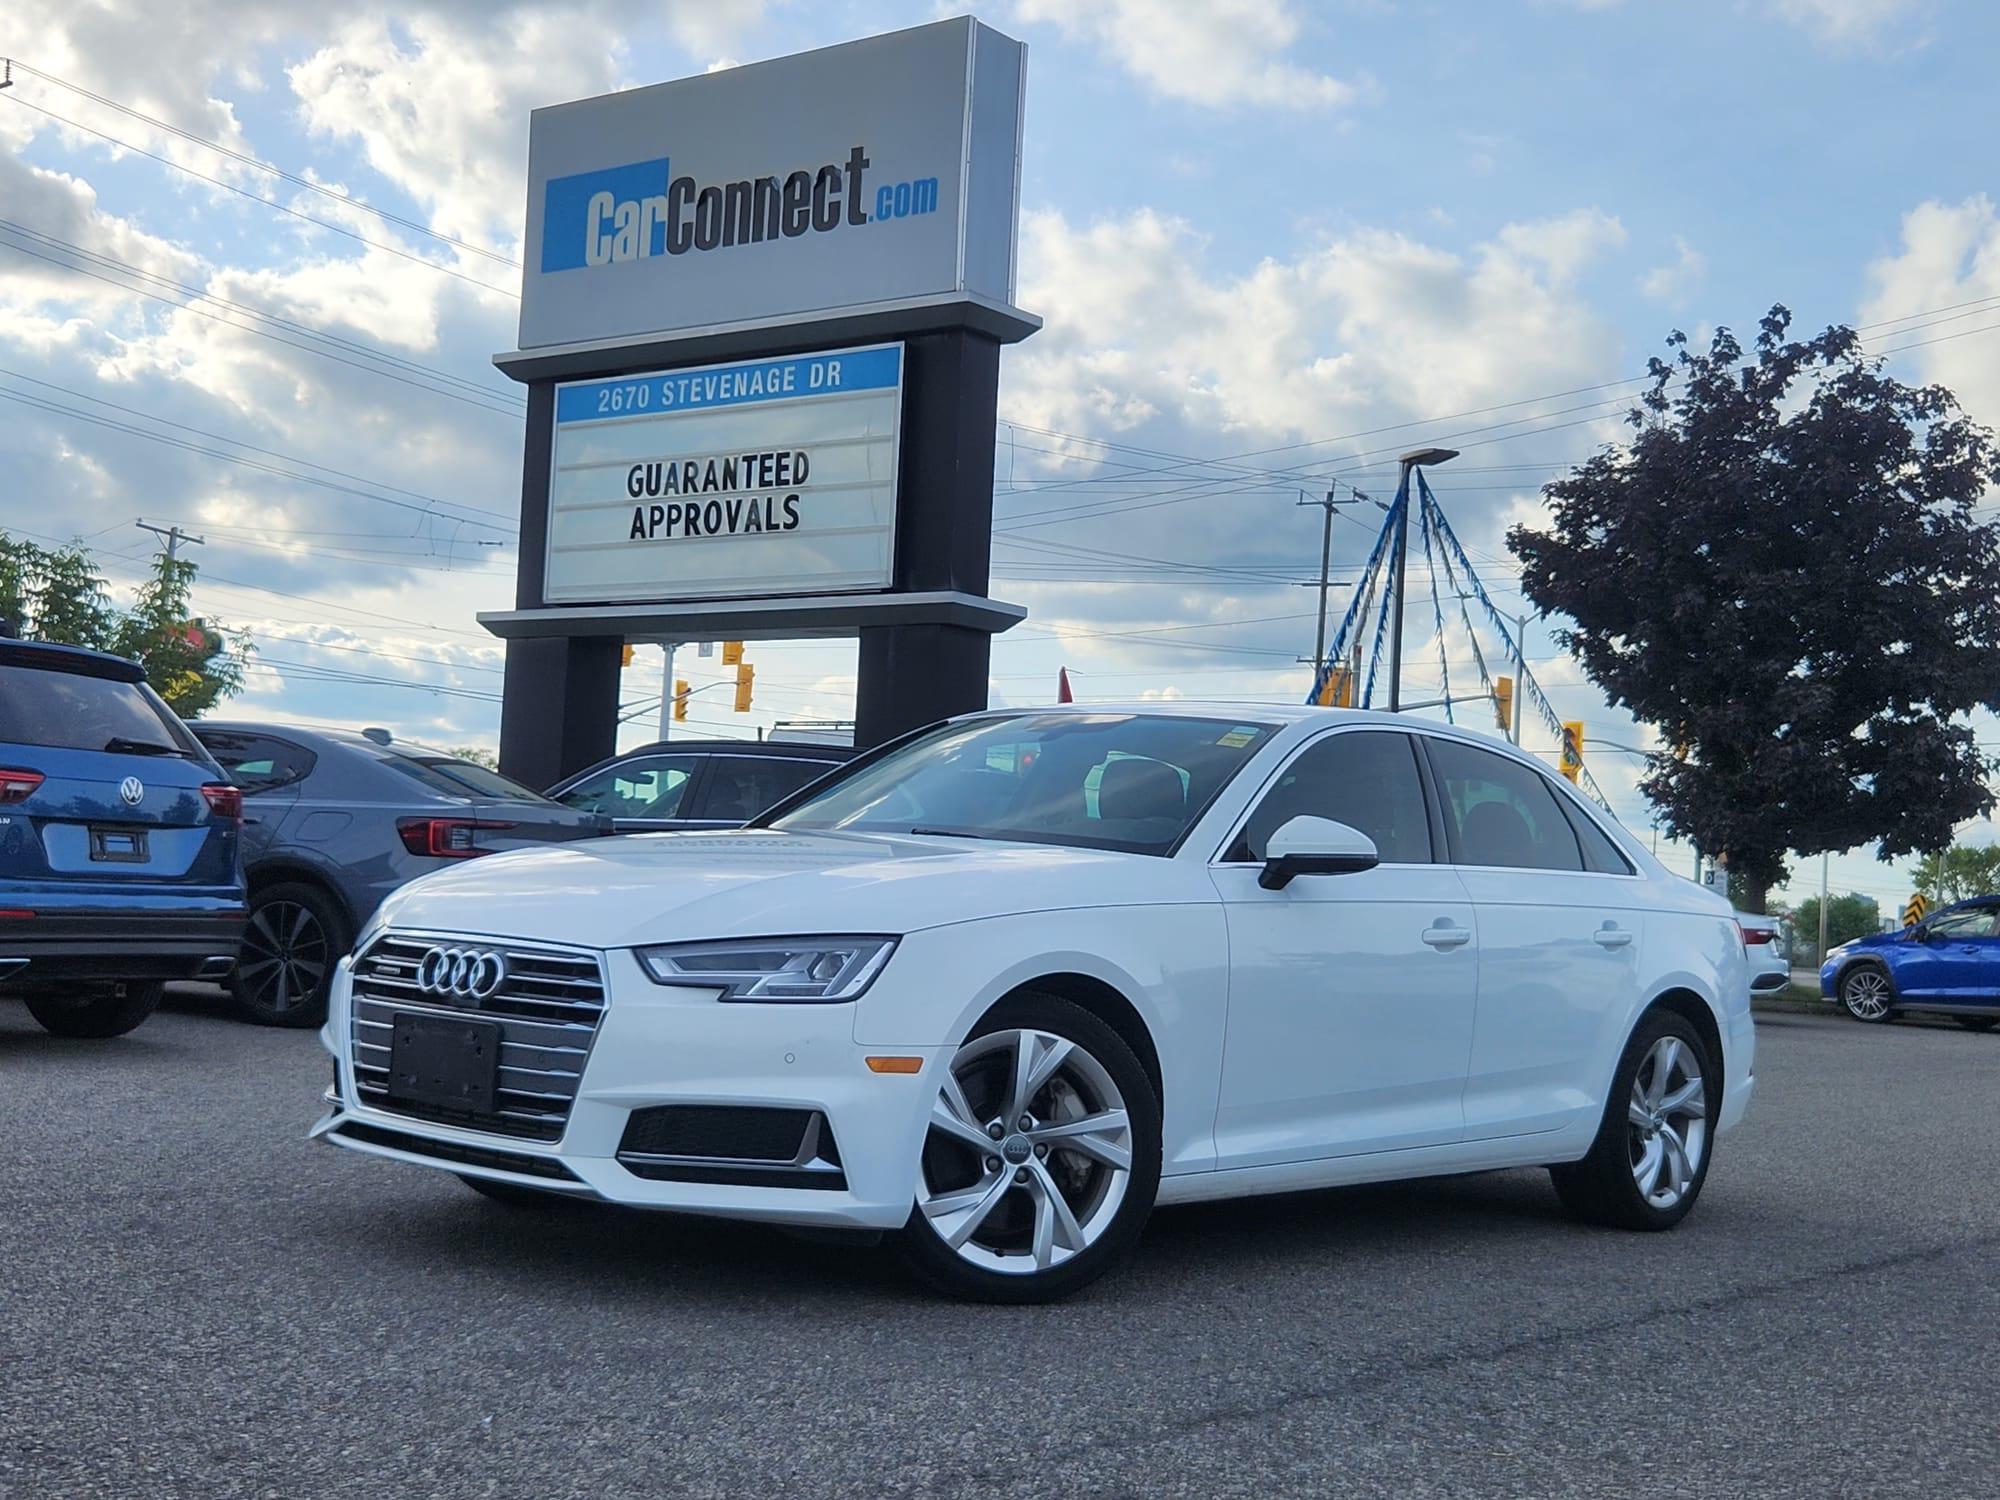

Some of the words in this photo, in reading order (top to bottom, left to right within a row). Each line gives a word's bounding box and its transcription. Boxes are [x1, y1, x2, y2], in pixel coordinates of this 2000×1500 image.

[585, 146, 939, 266] CarConnect.com
[598, 384, 649, 412] 2670
[662, 366, 796, 406] STEVENAGE
[810, 360, 841, 388] DR
[627, 450, 810, 498] GUARANTEED
[629, 493, 800, 540] APPROVALS
